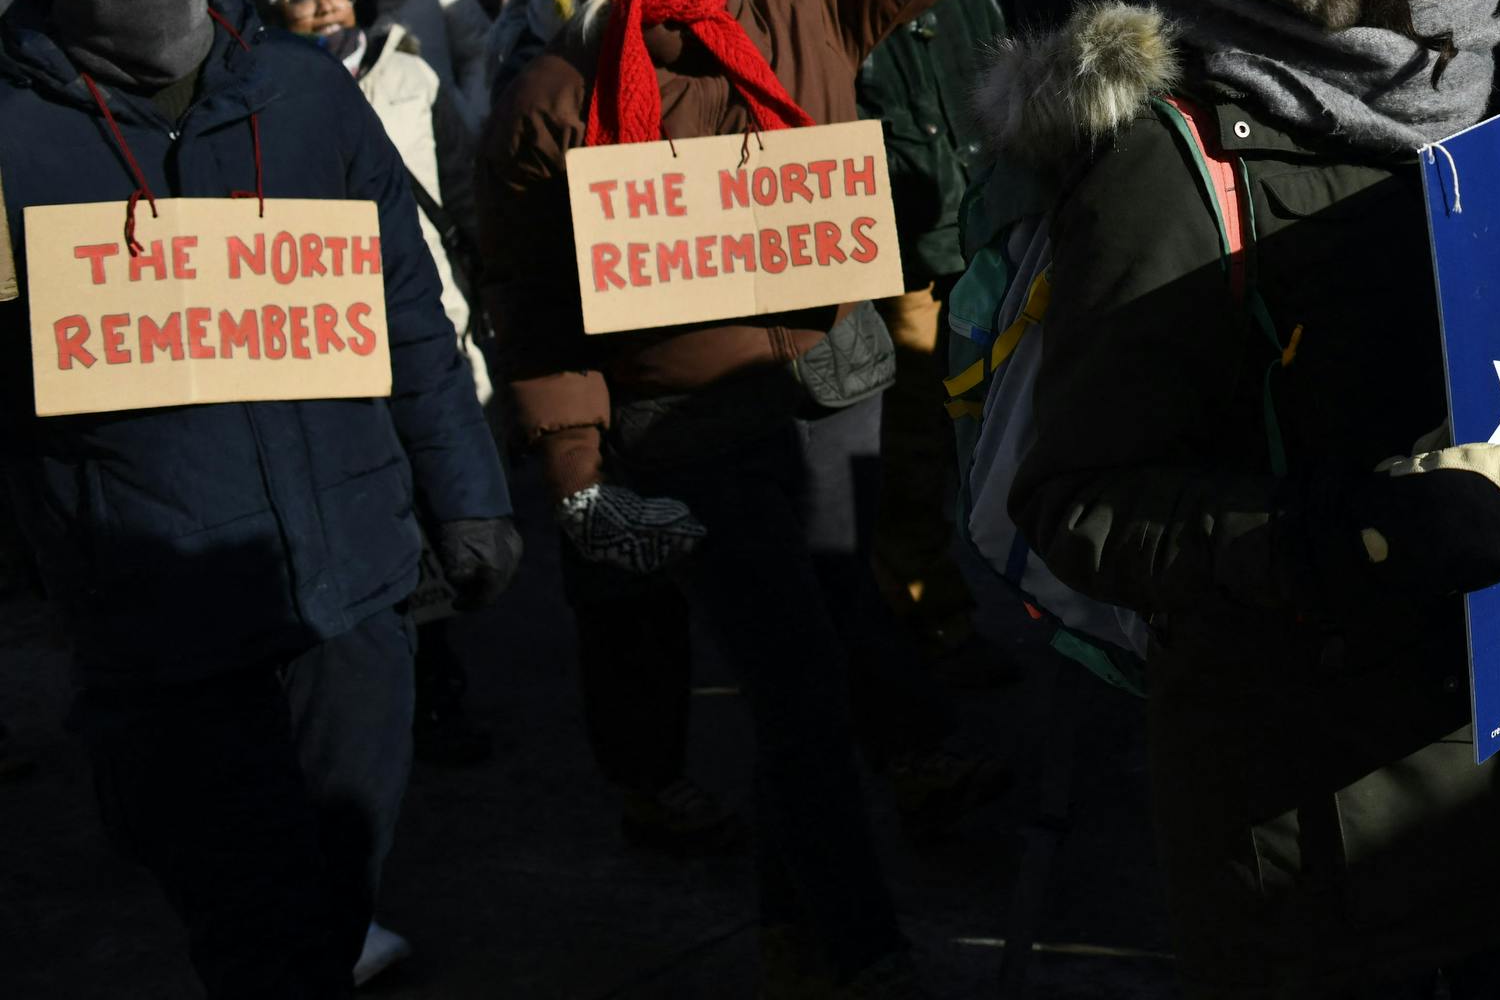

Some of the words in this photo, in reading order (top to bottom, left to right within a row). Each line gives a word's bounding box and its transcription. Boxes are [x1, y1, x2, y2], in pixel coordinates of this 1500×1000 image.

[588, 172, 688, 220] THE
[718, 155, 877, 210] NORTH
[74, 235, 198, 285] THE
[226, 230, 382, 286] NORTH
[590, 216, 880, 293] REMEMBERS
[53, 301, 377, 371] REMEMBERS
